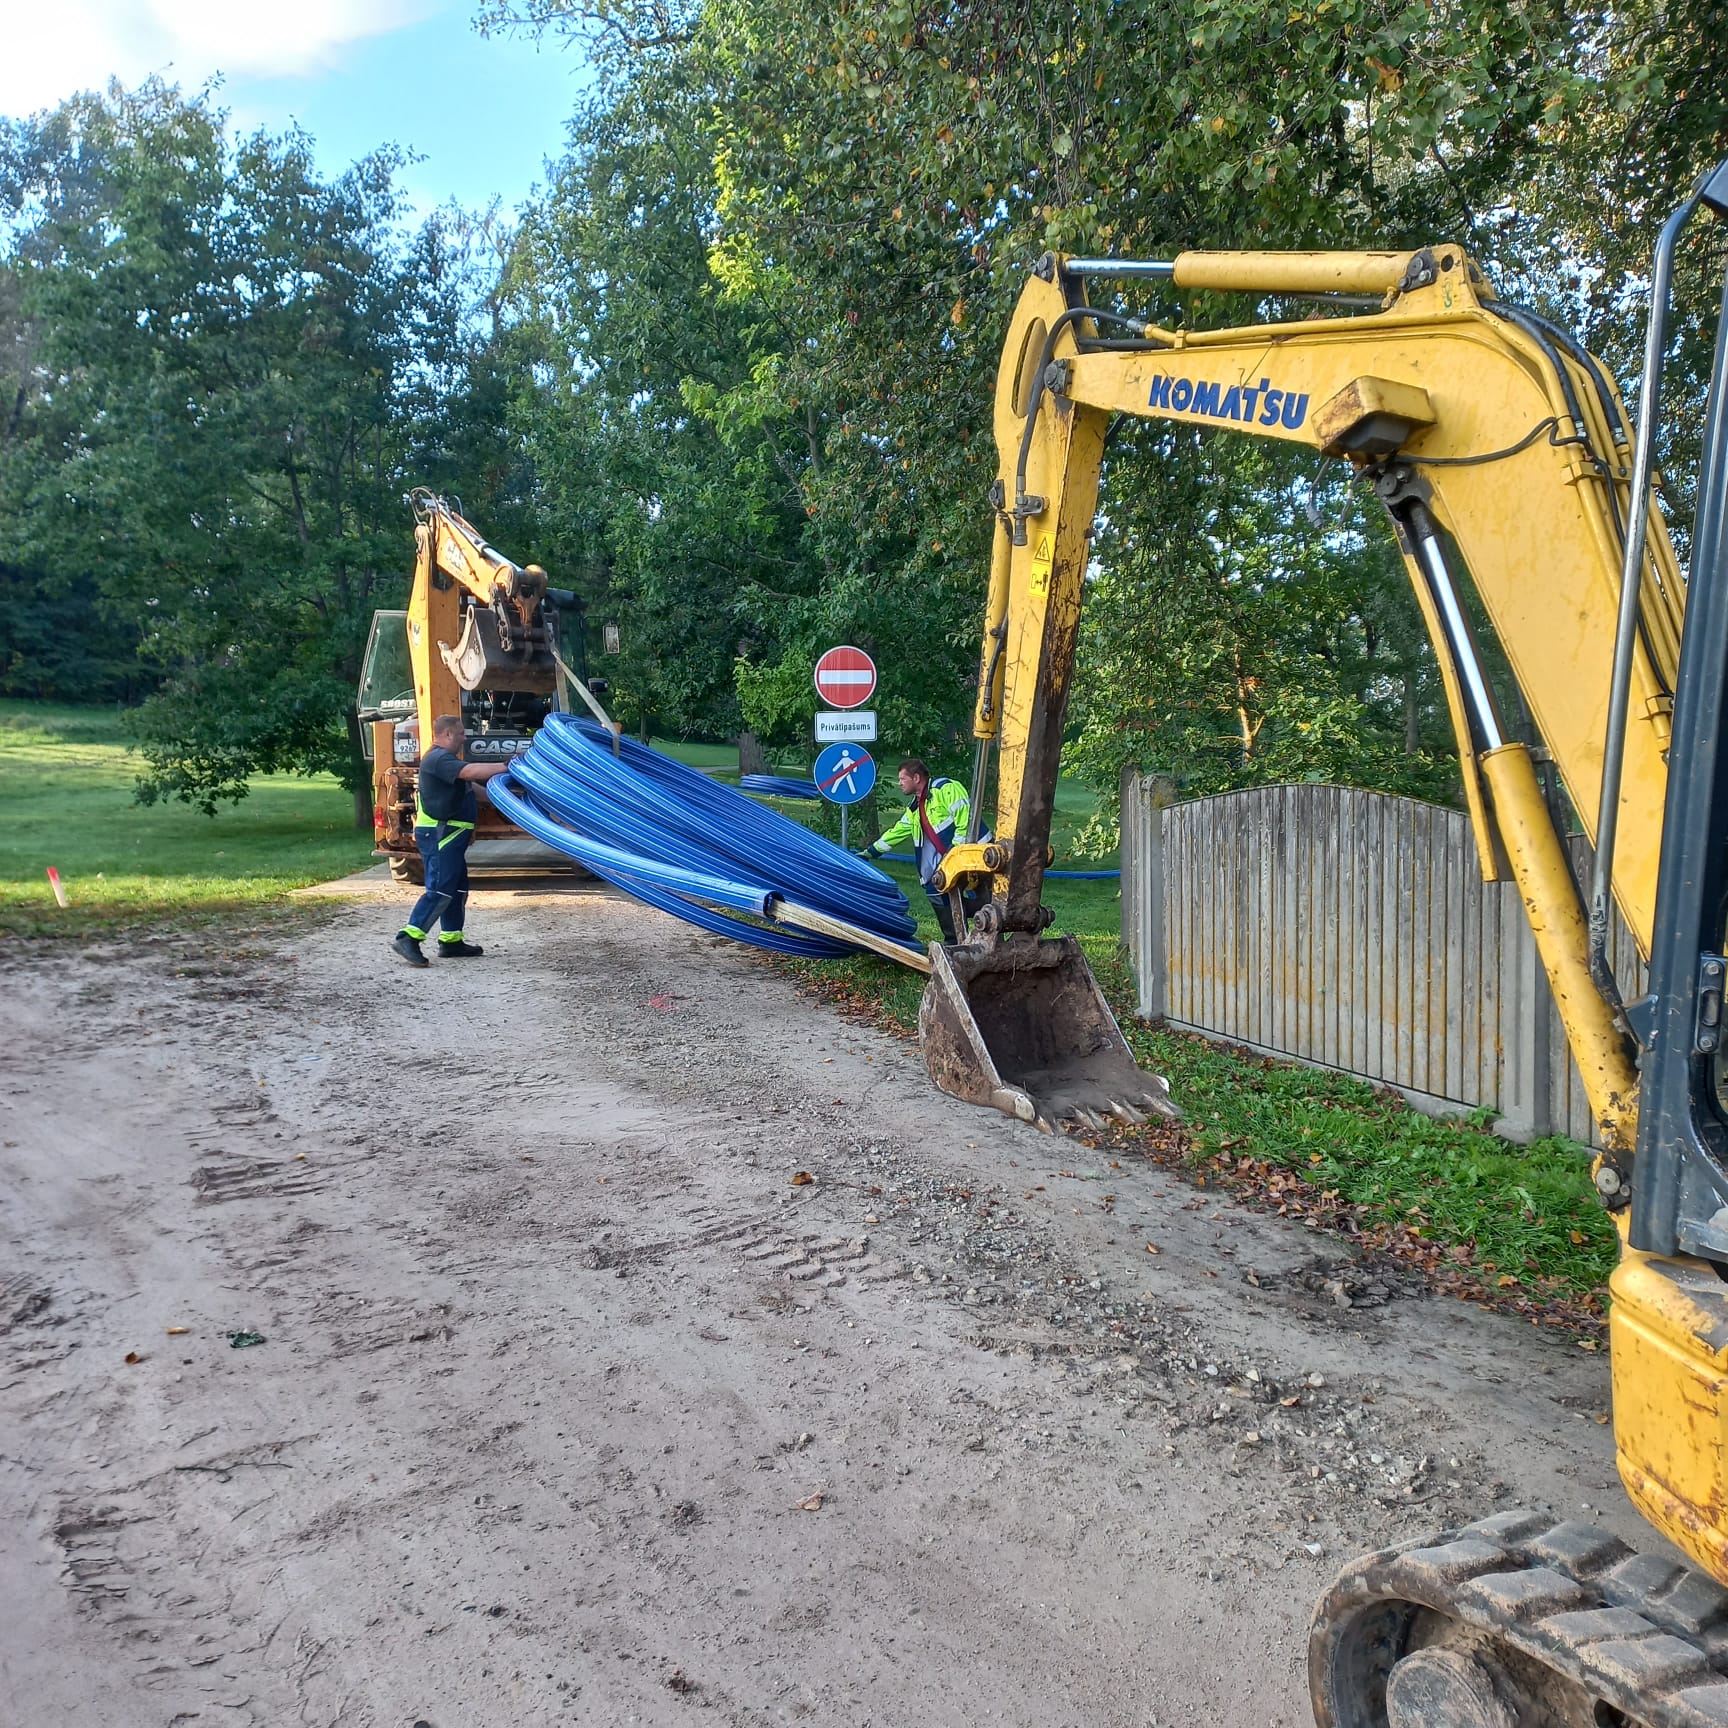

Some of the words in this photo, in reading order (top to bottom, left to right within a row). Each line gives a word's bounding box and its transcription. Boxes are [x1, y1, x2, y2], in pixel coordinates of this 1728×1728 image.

[1148, 375, 1310, 430] KOMATSU
[820, 722, 871, 733] Privātīpašums
[470, 740, 532, 754] CASE
